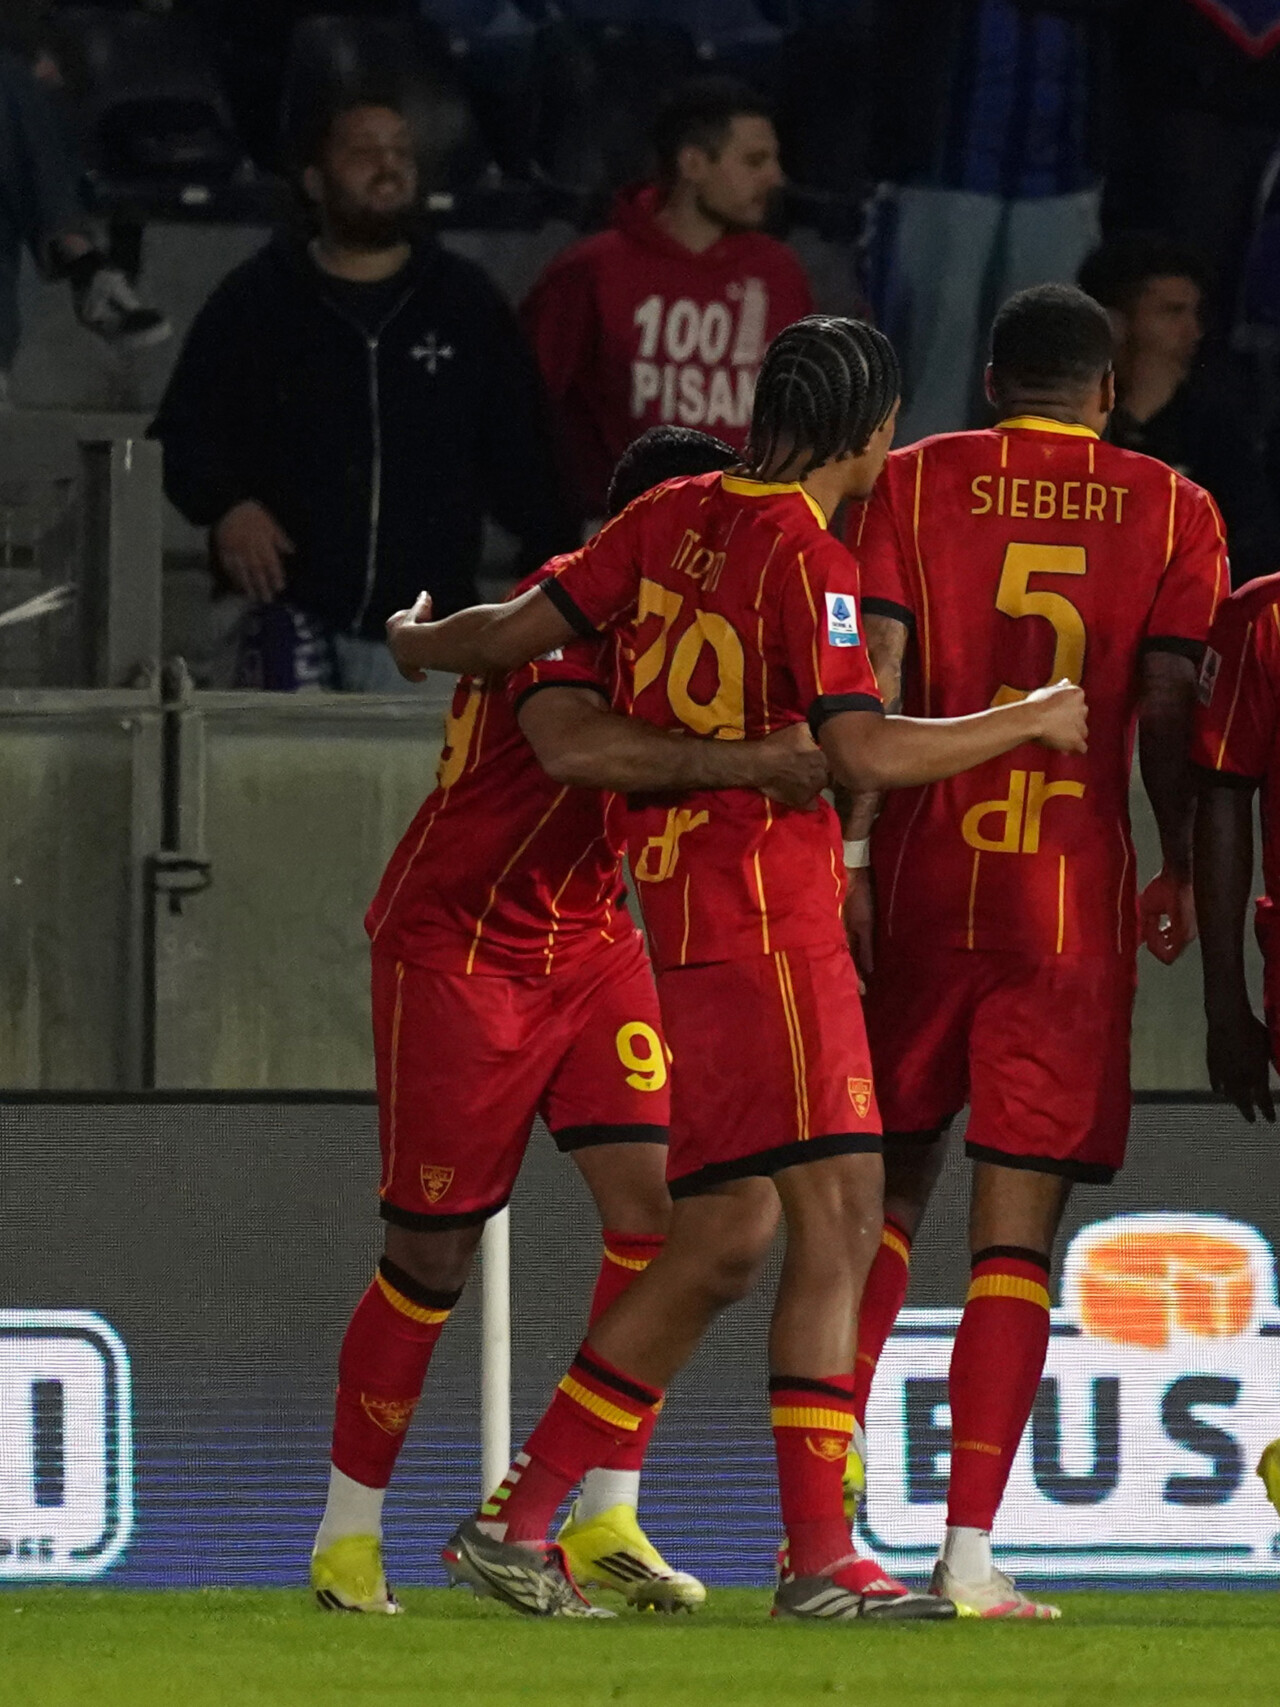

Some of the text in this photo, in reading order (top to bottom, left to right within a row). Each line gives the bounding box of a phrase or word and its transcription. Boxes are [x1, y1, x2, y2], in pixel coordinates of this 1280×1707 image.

[970, 474, 1129, 524] SIEBERT
[989, 541, 1087, 707] 5
[615, 1020, 674, 1092] 9
